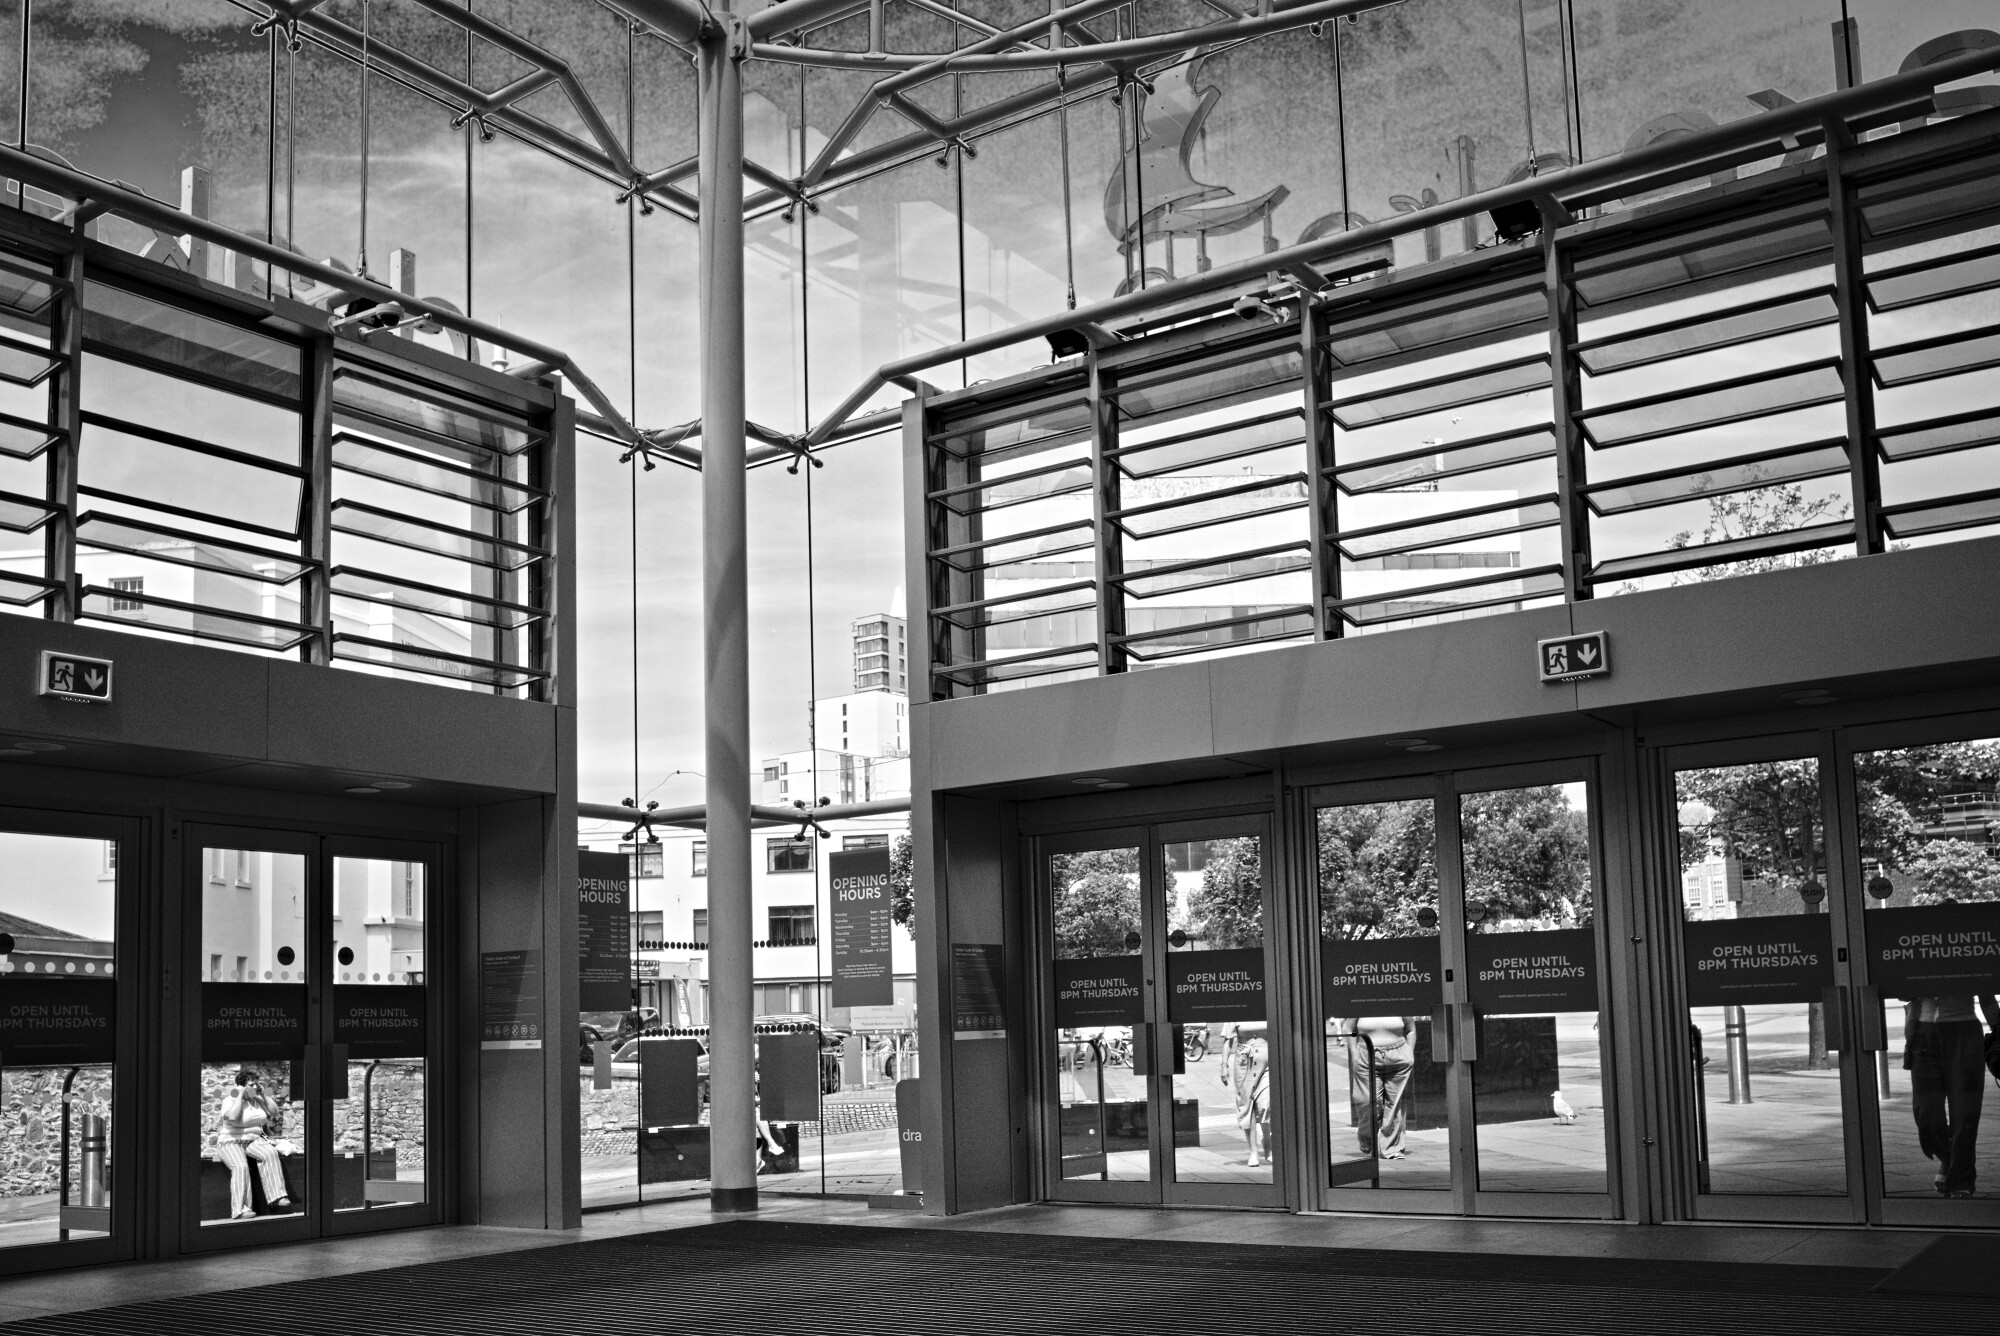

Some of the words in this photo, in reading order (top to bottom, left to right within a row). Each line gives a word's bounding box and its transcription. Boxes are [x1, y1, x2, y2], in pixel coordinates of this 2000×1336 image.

[833, 874, 887, 890] OPENING
[580, 890, 621, 904] HOURS
[840, 887, 881, 901] HOURS
[1899, 934, 1943, 948] OPEN
[1948, 931, 1998, 946] UNTIL
[1713, 946, 1753, 959] OPEN
[1758, 943, 1802, 957] UNTIL
[1883, 949, 1913, 960] 8PM
[1493, 958, 1528, 971] OPEN
[1532, 956, 1571, 969] UNTIL
[1698, 959, 1726, 970] 8PM
[1731, 953, 1817, 968] THURSDAYS
[1345, 964, 1378, 976] OPEN
[1382, 962, 1417, 972] UNTIL
[1480, 970, 1504, 980] 8PM
[1509, 966, 1585, 979] THURSDAYS
[1071, 980, 1096, 988] OPEN
[1100, 978, 1128, 989] UNTIL
[1188, 973, 1216, 984] OPEN
[1220, 972, 1251, 983] UNTIL
[1333, 976, 1356, 985] 8PM
[1360, 971, 1431, 984] THURSDAYS
[1061, 991, 1079, 999] 8PM
[1082, 986, 1138, 998] THURSDAYS
[1177, 984, 1197, 993] 8PM
[1200, 980, 1262, 992] THURSDAYS
[10, 1006, 48, 1016] OPEN
[53, 1005, 92, 1015] UNTIL
[220, 1008, 250, 1017] OPEN
[254, 1008, 286, 1017] UNTIL
[350, 1009, 377, 1017] OPEN
[27, 1017, 106, 1028] THURSDAYS
[208, 1019, 229, 1028] 8PM
[234, 1019, 297, 1028] THURSDAYS
[339, 1019, 359, 1027] 8PM
[362, 1018, 418, 1027] THURSDAYS
